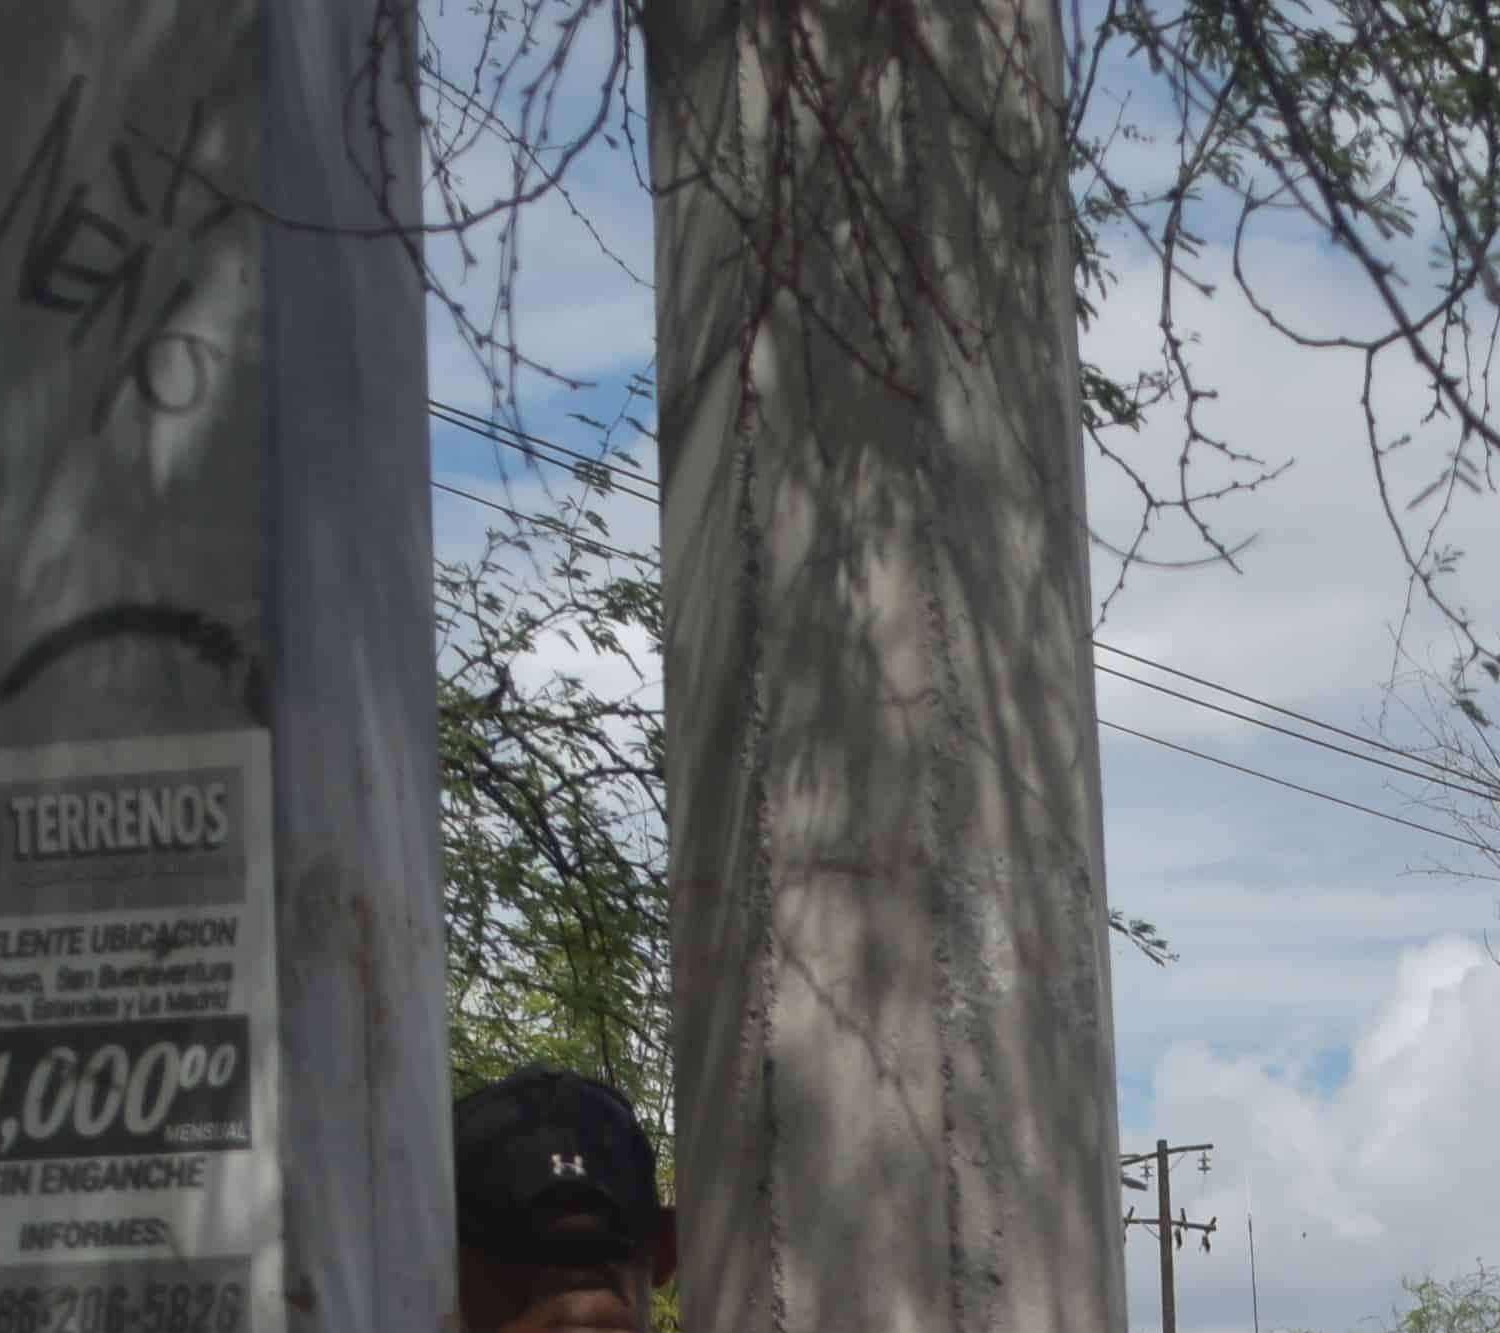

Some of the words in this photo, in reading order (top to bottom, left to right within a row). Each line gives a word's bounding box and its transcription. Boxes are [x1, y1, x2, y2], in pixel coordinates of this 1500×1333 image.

[11, 781, 229, 858] TERRENOS
[90, 917, 238, 955] UBICACION
[40, 1157, 205, 1195] ENGANCHE
